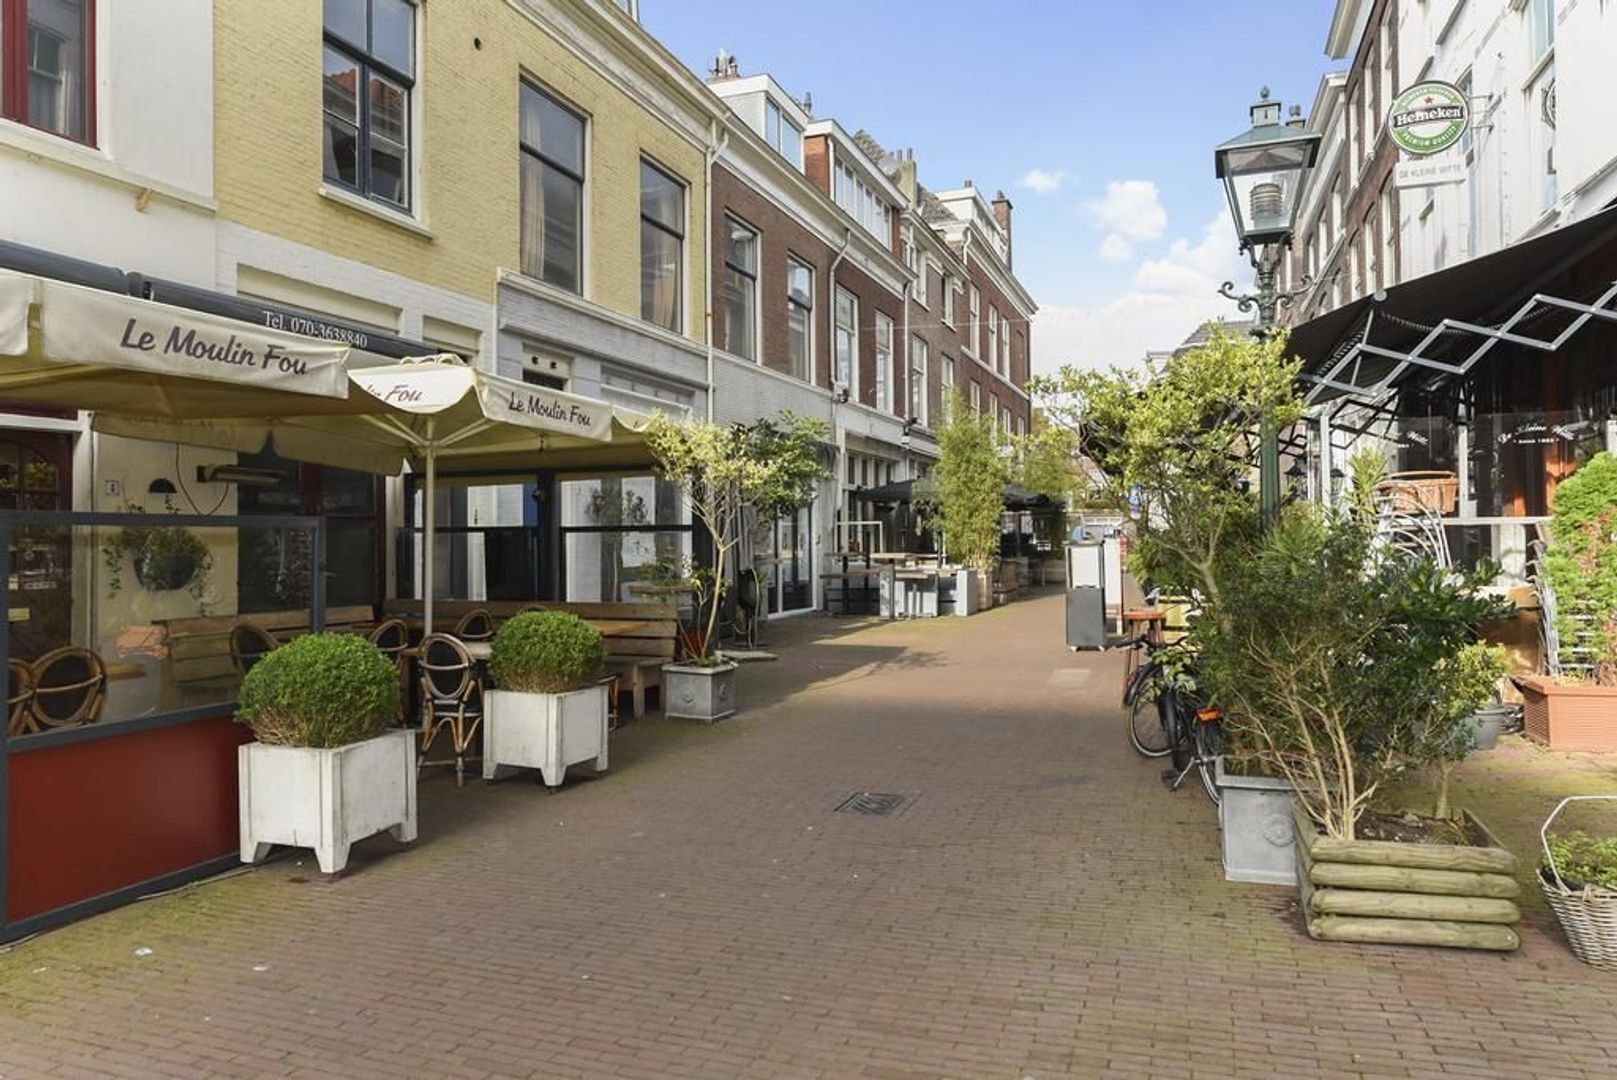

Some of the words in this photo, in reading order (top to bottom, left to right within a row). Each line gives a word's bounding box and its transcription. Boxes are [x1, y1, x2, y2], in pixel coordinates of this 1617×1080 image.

[1397, 107, 1462, 126] Heineken
[119, 318, 155, 352] Le
[163, 326, 257, 367] Moulin
[261, 344, 308, 376] Fou
[262, 310, 287, 330] Tel.
[290, 317, 368, 348] 070-3638840
[384, 384, 424, 402] Fou
[508, 391, 525, 413] Le
[527, 395, 567, 421] Moulin
[569, 404, 591, 427] Fou
